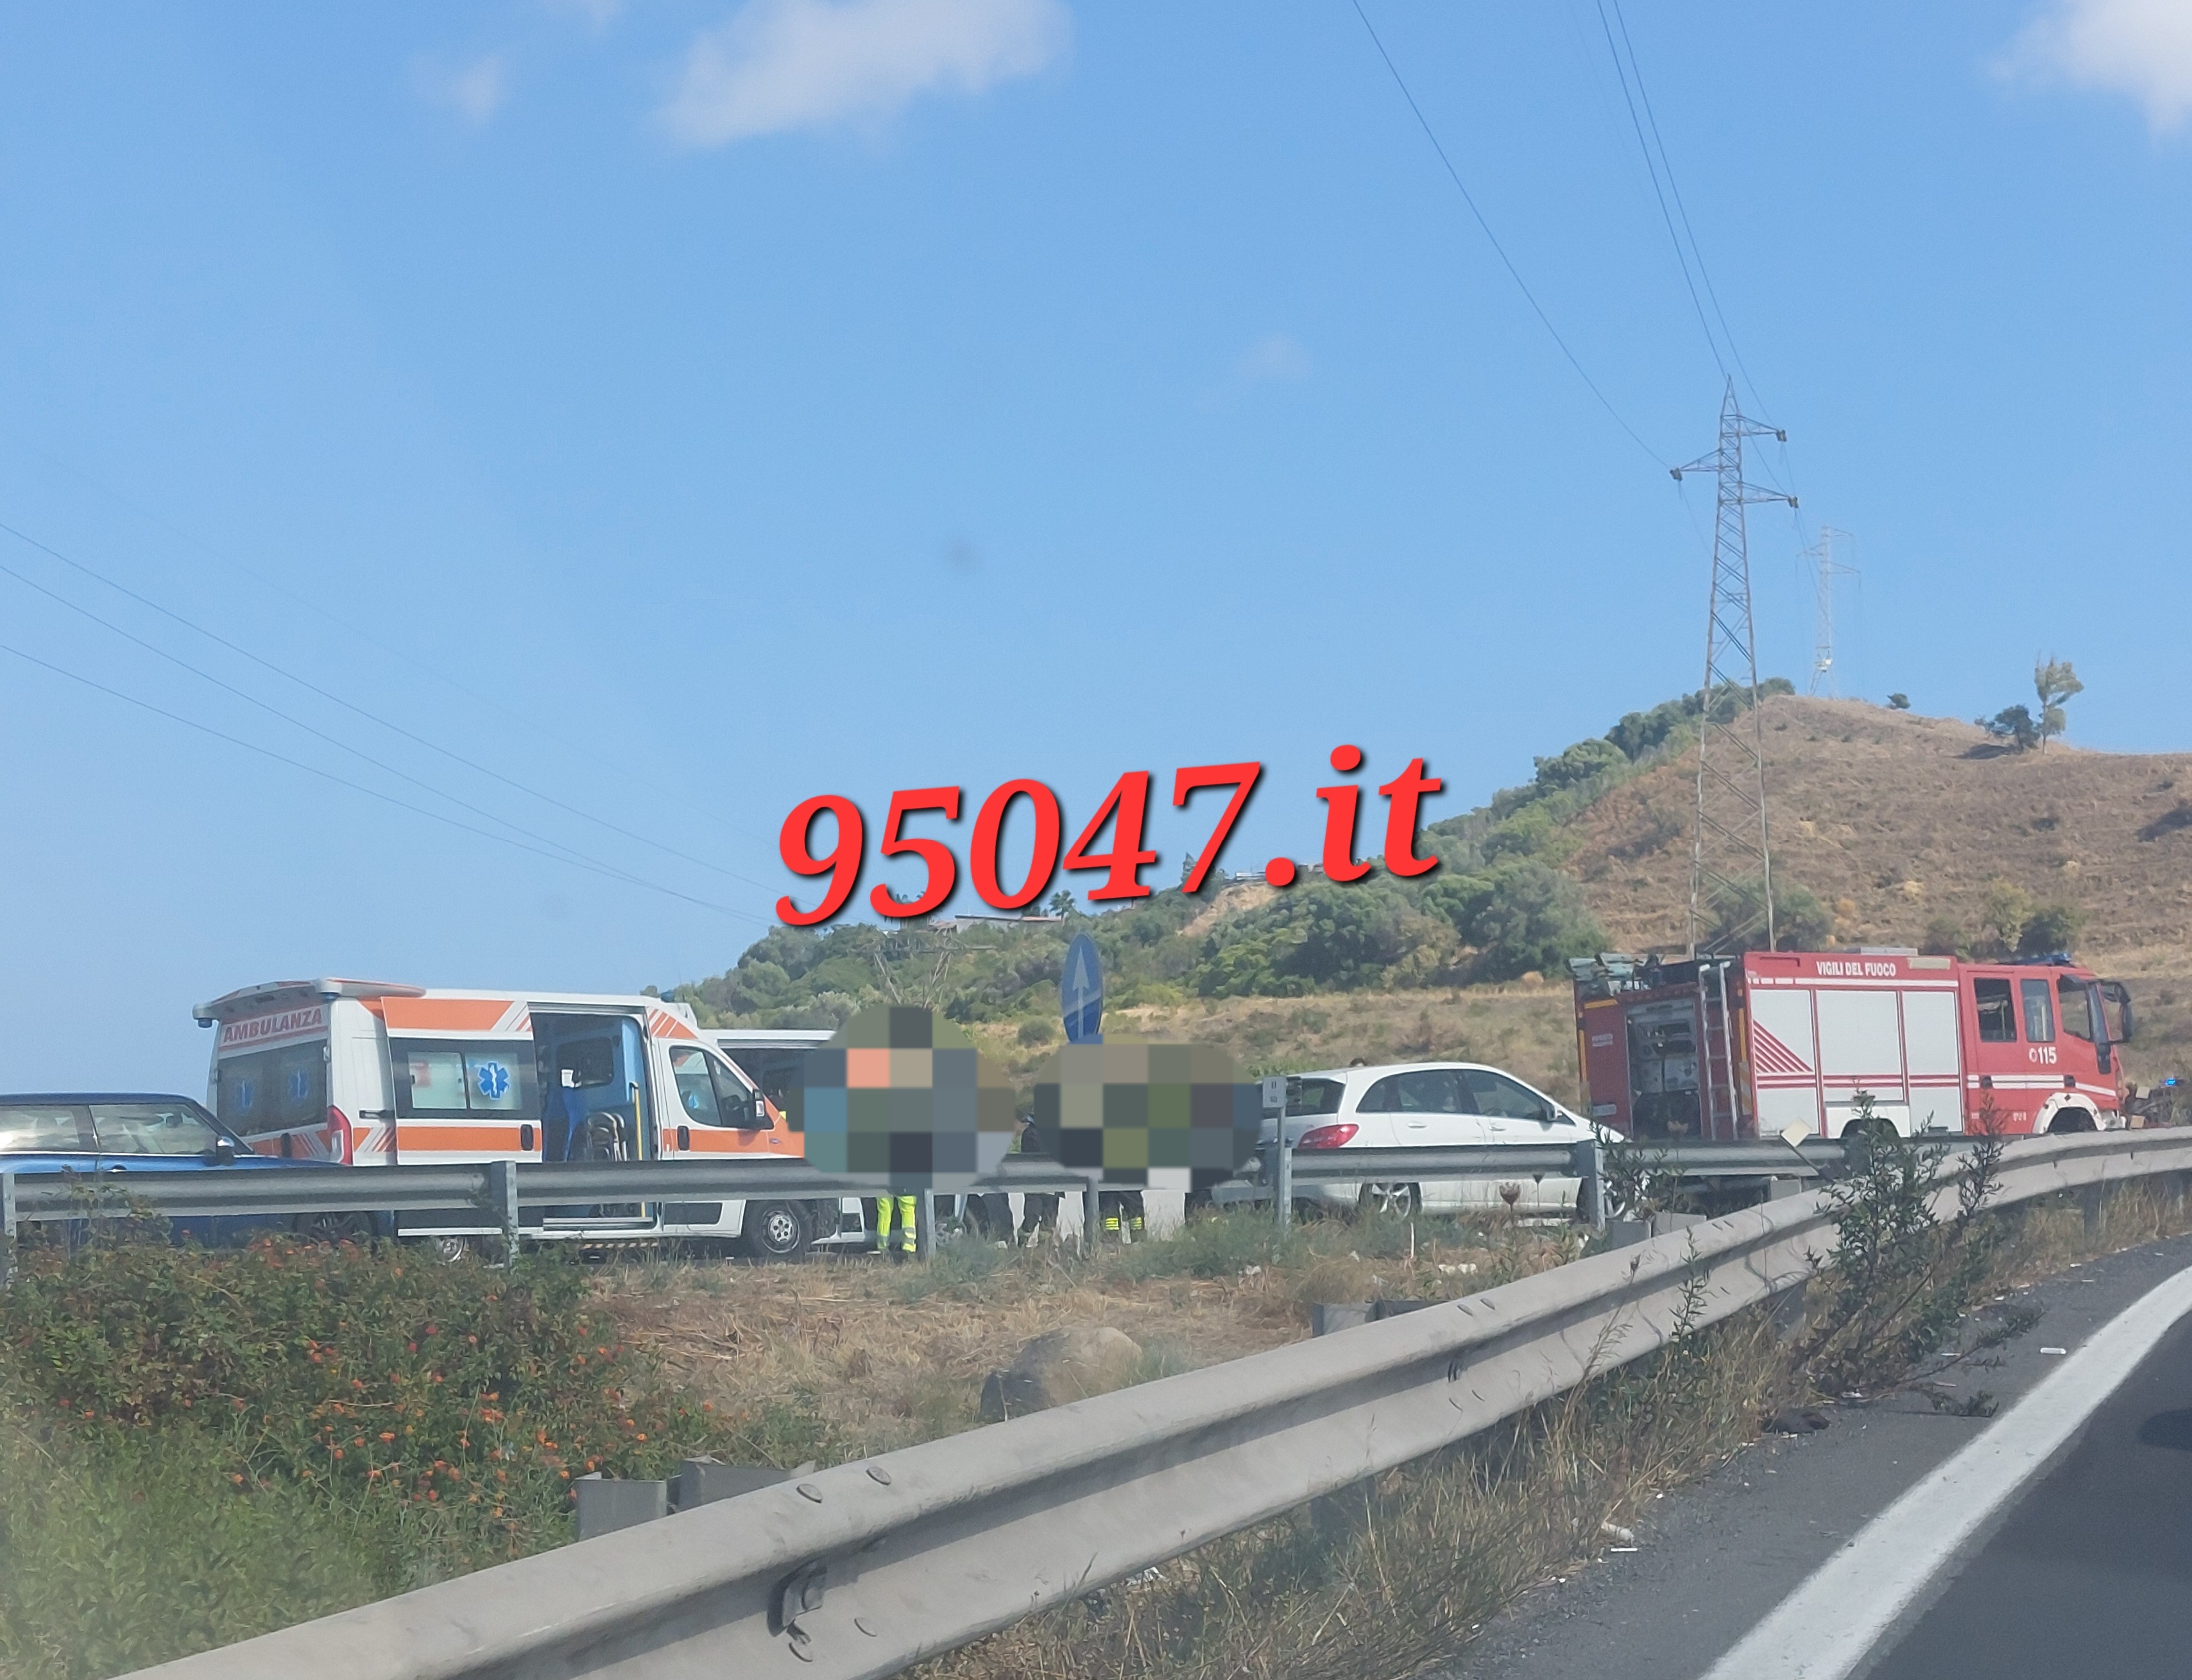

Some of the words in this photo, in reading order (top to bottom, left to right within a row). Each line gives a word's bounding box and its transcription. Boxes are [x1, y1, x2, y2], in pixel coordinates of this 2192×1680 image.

[1816, 961, 1844, 976] VIGILI
[1844, 961, 1863, 976] DEL
[1864, 962, 1896, 977] FUOCO
[224, 1008, 322, 1043] AMBULANZA
